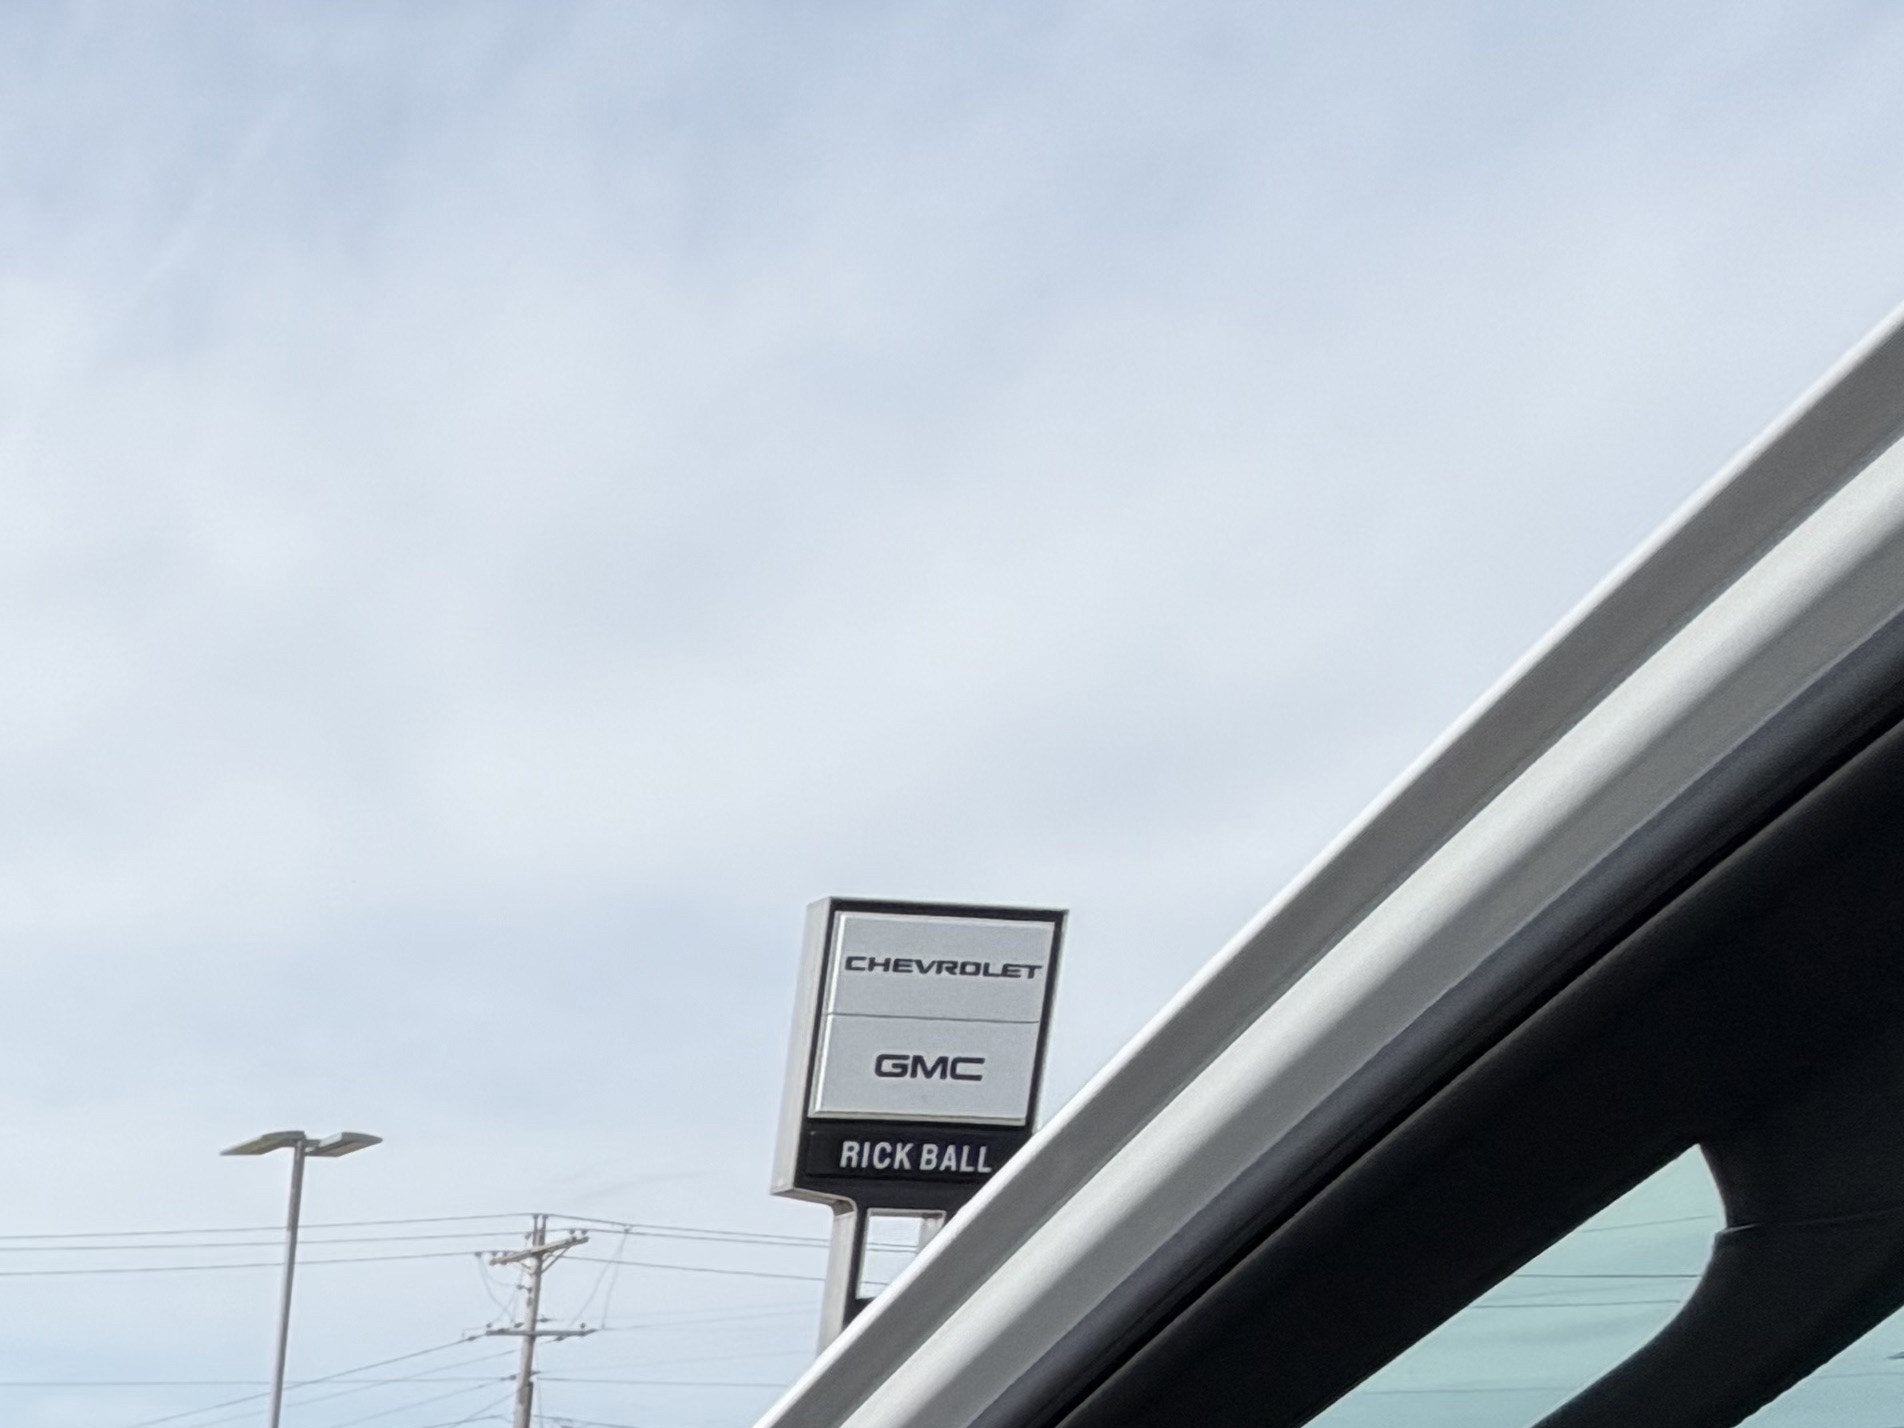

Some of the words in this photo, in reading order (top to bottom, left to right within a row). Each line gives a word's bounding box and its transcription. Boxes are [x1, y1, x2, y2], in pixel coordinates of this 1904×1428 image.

[845, 956, 1043, 979] CHEVROLET
[874, 1054, 986, 1081] GMC
[840, 1140, 914, 1170] RICK
[919, 1143, 993, 1173] BALL
